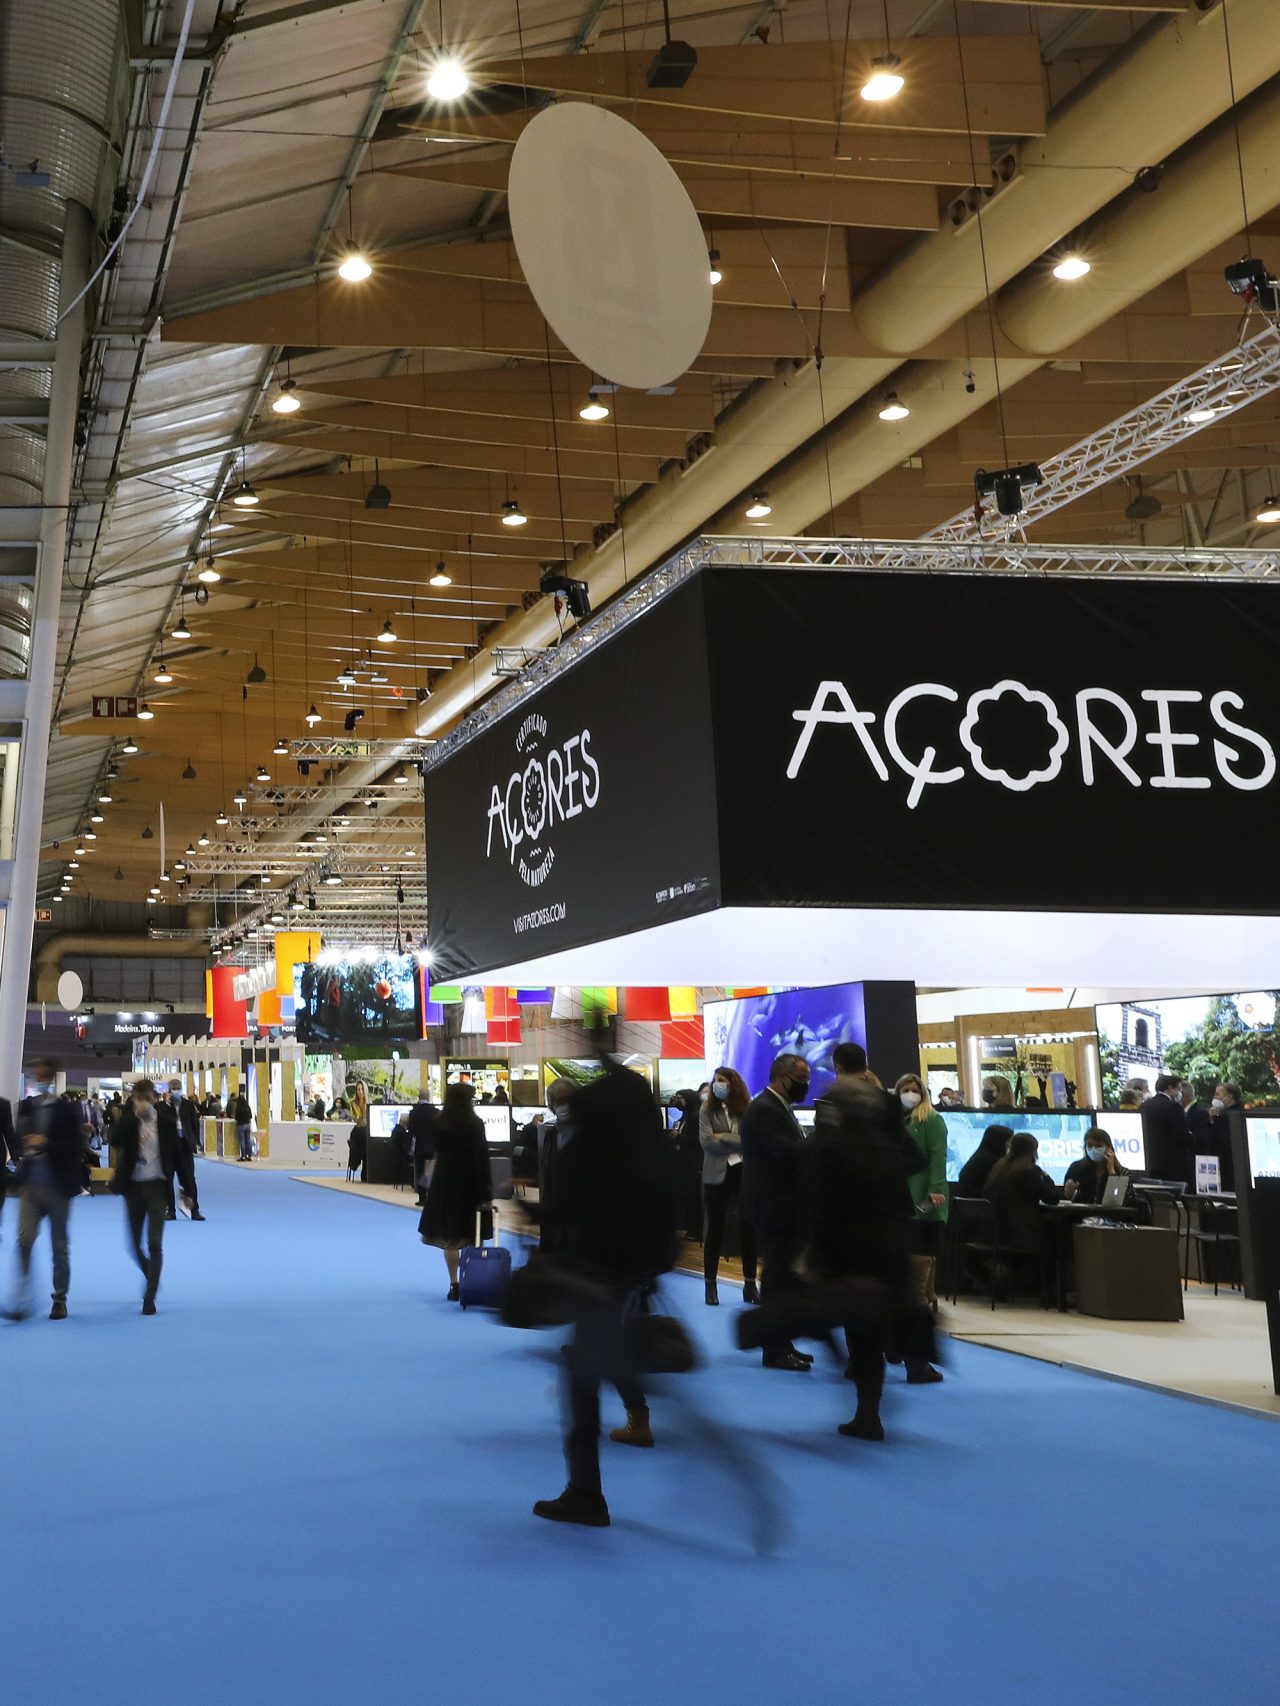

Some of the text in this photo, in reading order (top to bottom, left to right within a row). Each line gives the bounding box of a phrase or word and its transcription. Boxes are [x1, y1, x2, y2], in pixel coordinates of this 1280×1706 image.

[516, 713, 548, 752] CERTIFICADO
[786, 679, 1277, 809] AÇORES
[486, 729, 600, 865] AÇORES
[531, 847, 556, 887] NATUREZA
